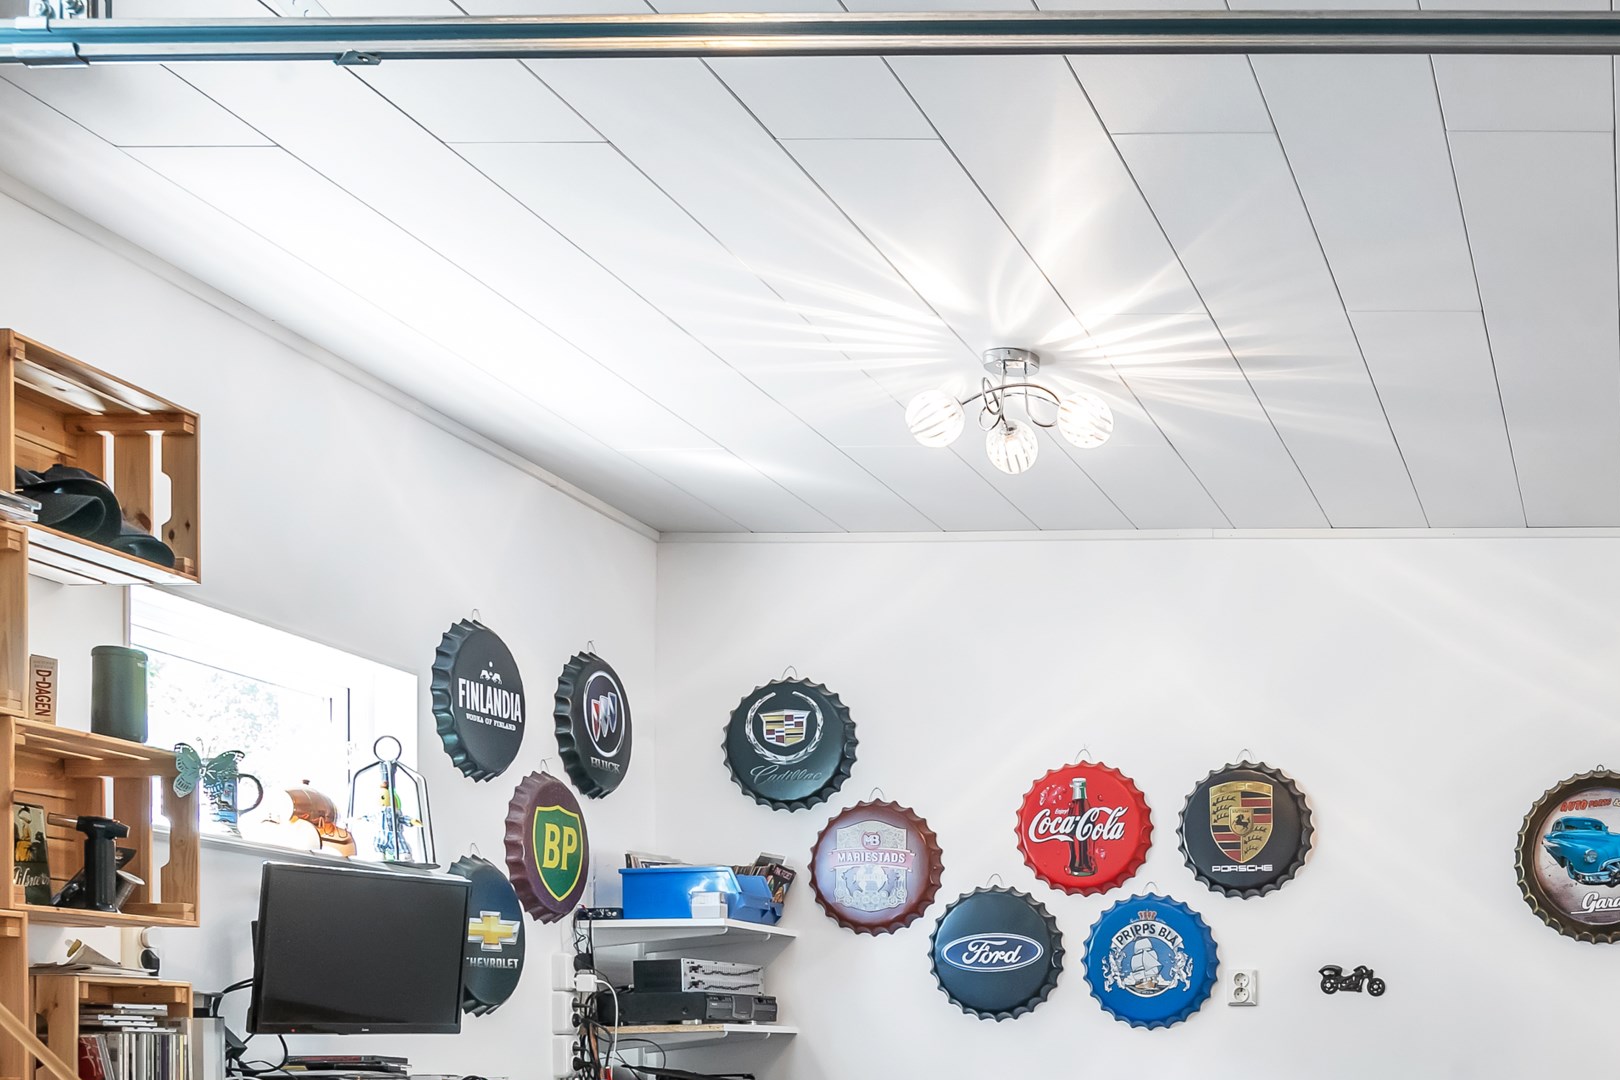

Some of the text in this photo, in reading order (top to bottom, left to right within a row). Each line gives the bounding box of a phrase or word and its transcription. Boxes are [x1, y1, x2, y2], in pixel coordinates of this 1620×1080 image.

[35, 669, 52, 716] D-DAGEN
[457, 678, 522, 723] FINLANDIA
[590, 756, 621, 774] BUICK
[749, 763, 823, 785] Cadillac
[1028, 806, 1129, 843] Coca-Cola
[542, 822, 578, 871] BP
[836, 851, 906, 864] MARIESTADS
[1211, 864, 1273, 873] PORSCHE
[1115, 923, 1178, 946] PRIPPS BLÅ
[961, 940, 1022, 966] Ford
